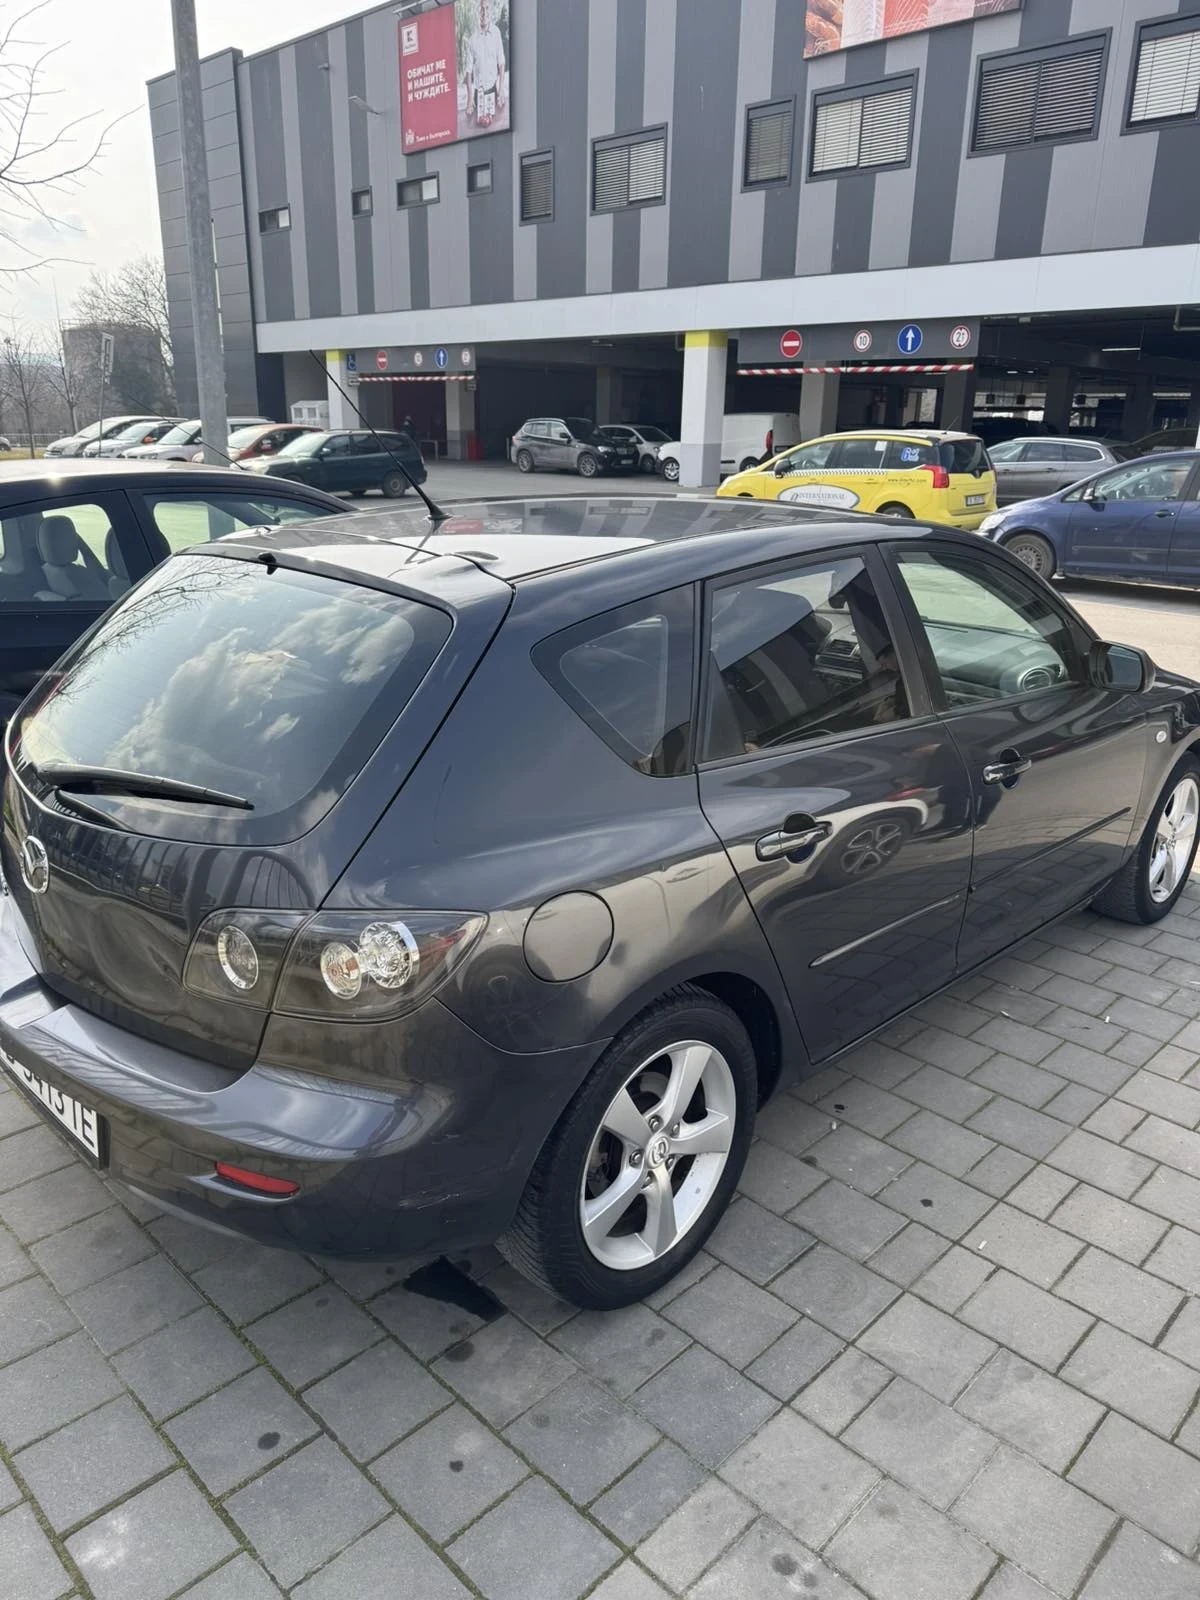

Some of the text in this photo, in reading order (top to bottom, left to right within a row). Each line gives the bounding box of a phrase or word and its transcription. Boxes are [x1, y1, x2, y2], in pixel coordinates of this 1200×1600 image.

[408, 59, 446, 79] ОБИЧАТ МЕ
[407, 81, 413, 91] И
[408, 92, 413, 103] И
[859, 335, 868, 347] 10
